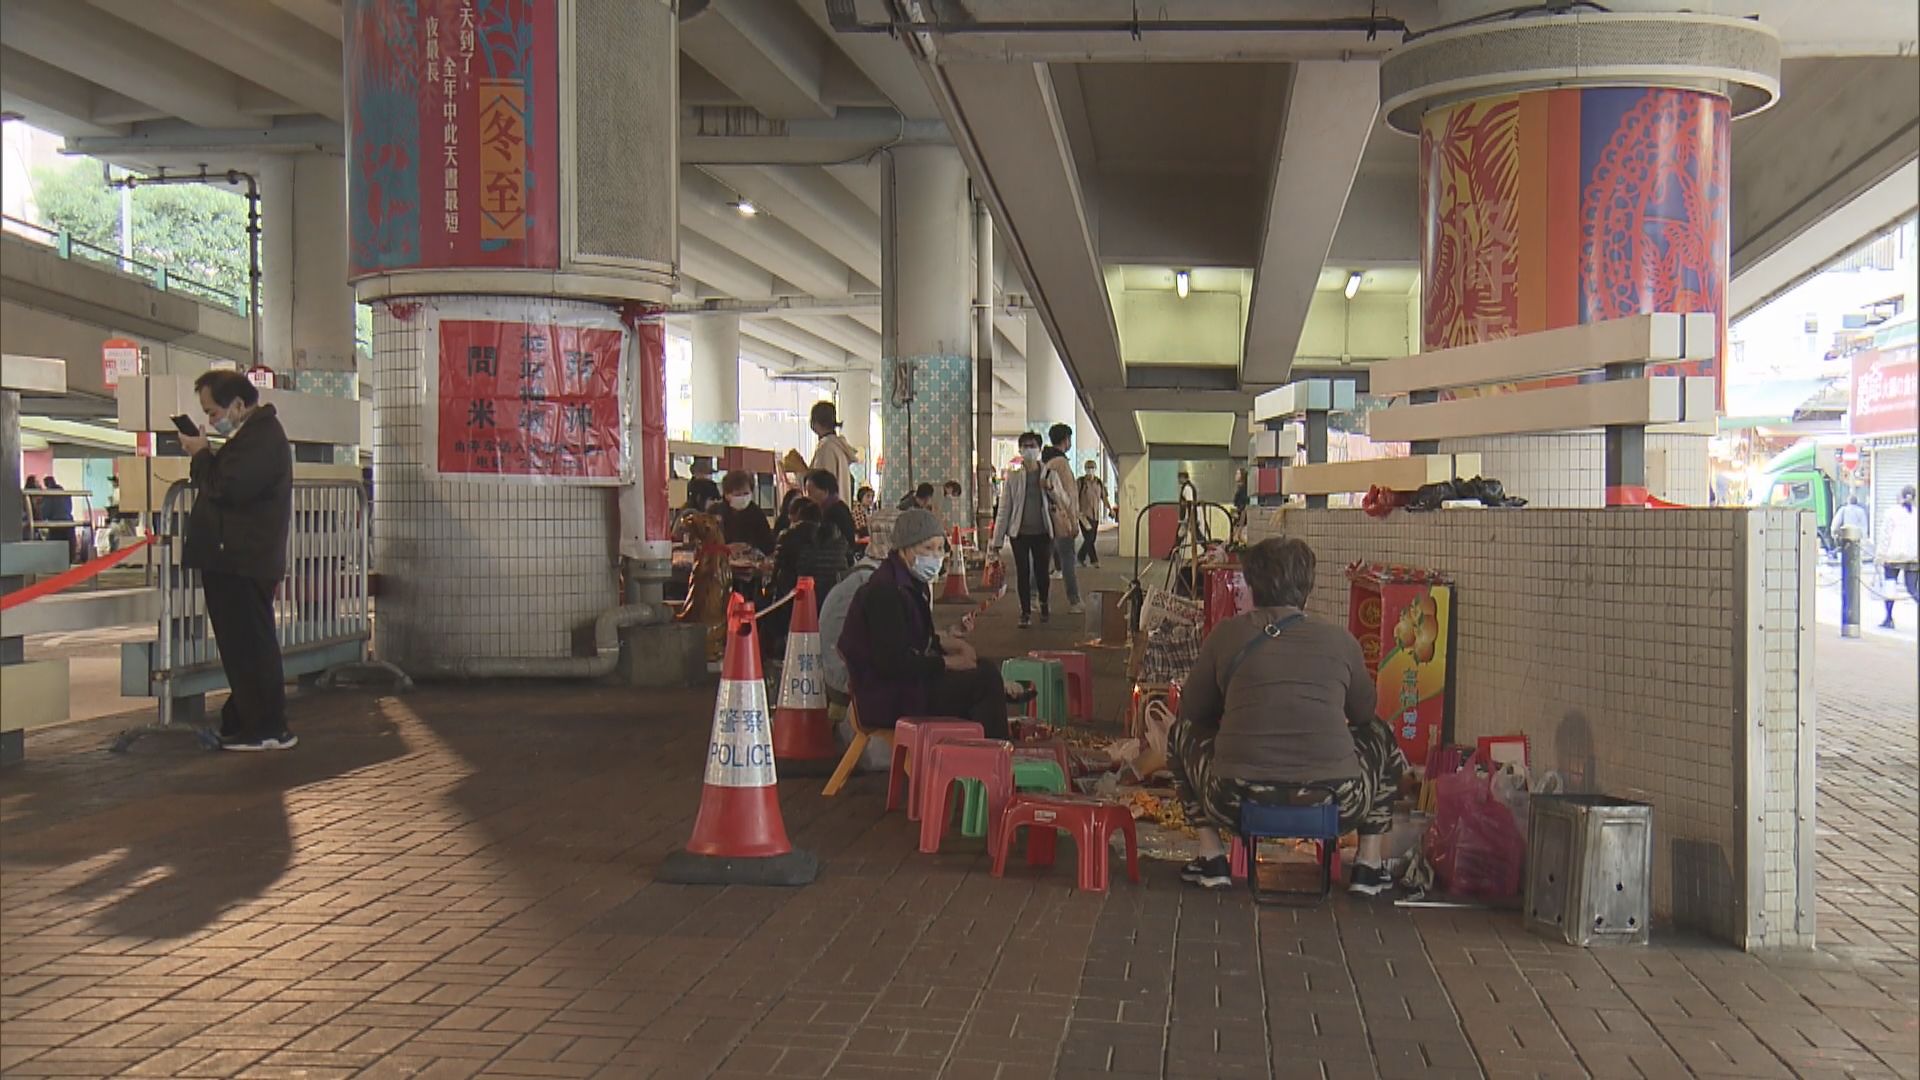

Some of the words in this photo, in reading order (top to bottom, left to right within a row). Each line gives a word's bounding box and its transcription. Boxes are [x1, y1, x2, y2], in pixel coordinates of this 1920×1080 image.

[459, 0, 475, 90] 天到了，
[483, 109, 523, 213] 冬至
[719, 708, 763, 733] 警察
[711, 742, 773, 767] POLICE
